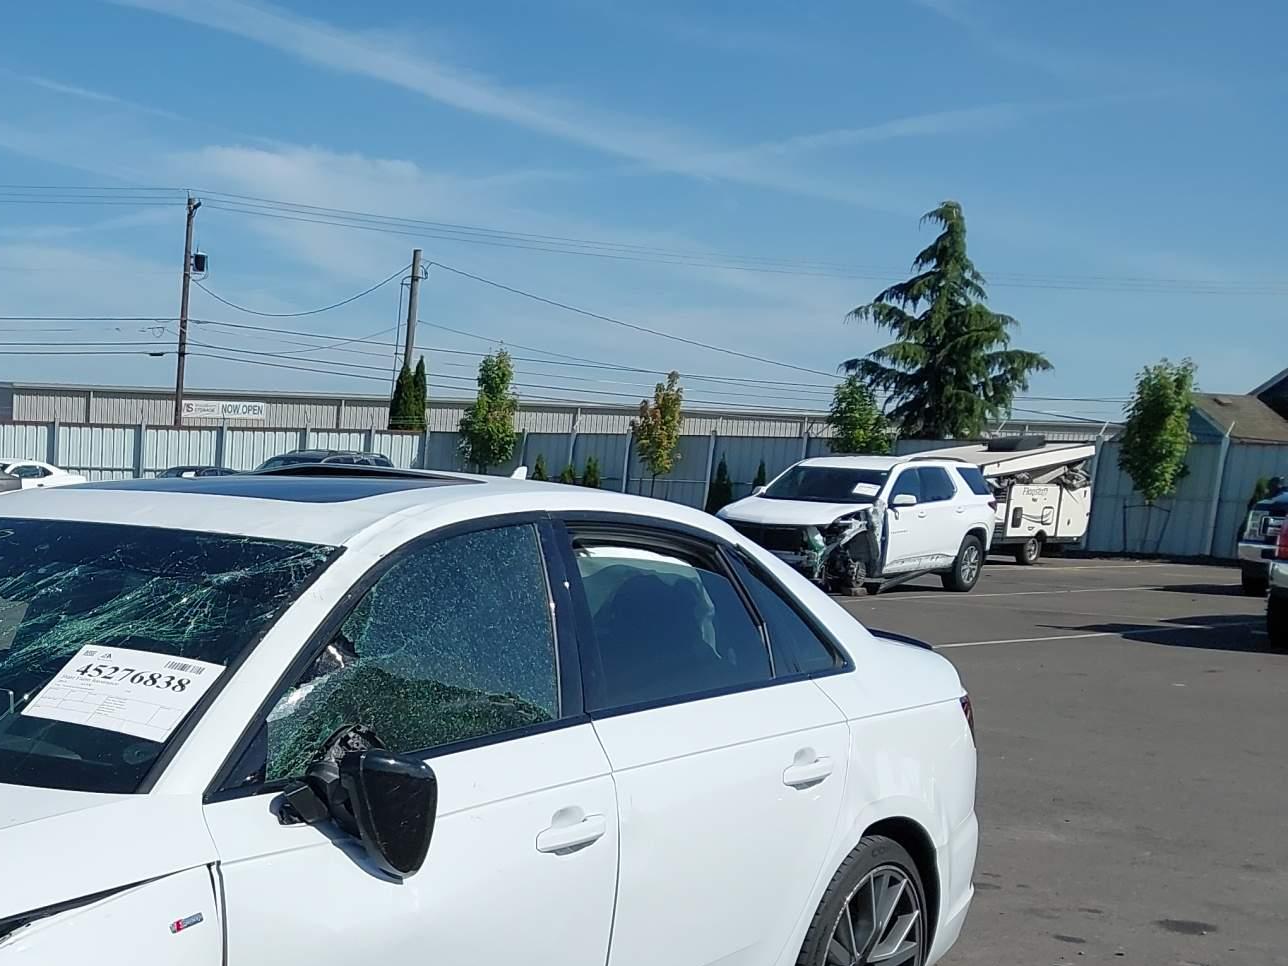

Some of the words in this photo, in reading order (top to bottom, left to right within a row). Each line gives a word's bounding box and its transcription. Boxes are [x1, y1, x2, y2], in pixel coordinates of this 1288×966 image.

[221, 404, 241, 414] NOW
[241, 404, 264, 415] OPEN
[76, 663, 191, 693] 45276838
